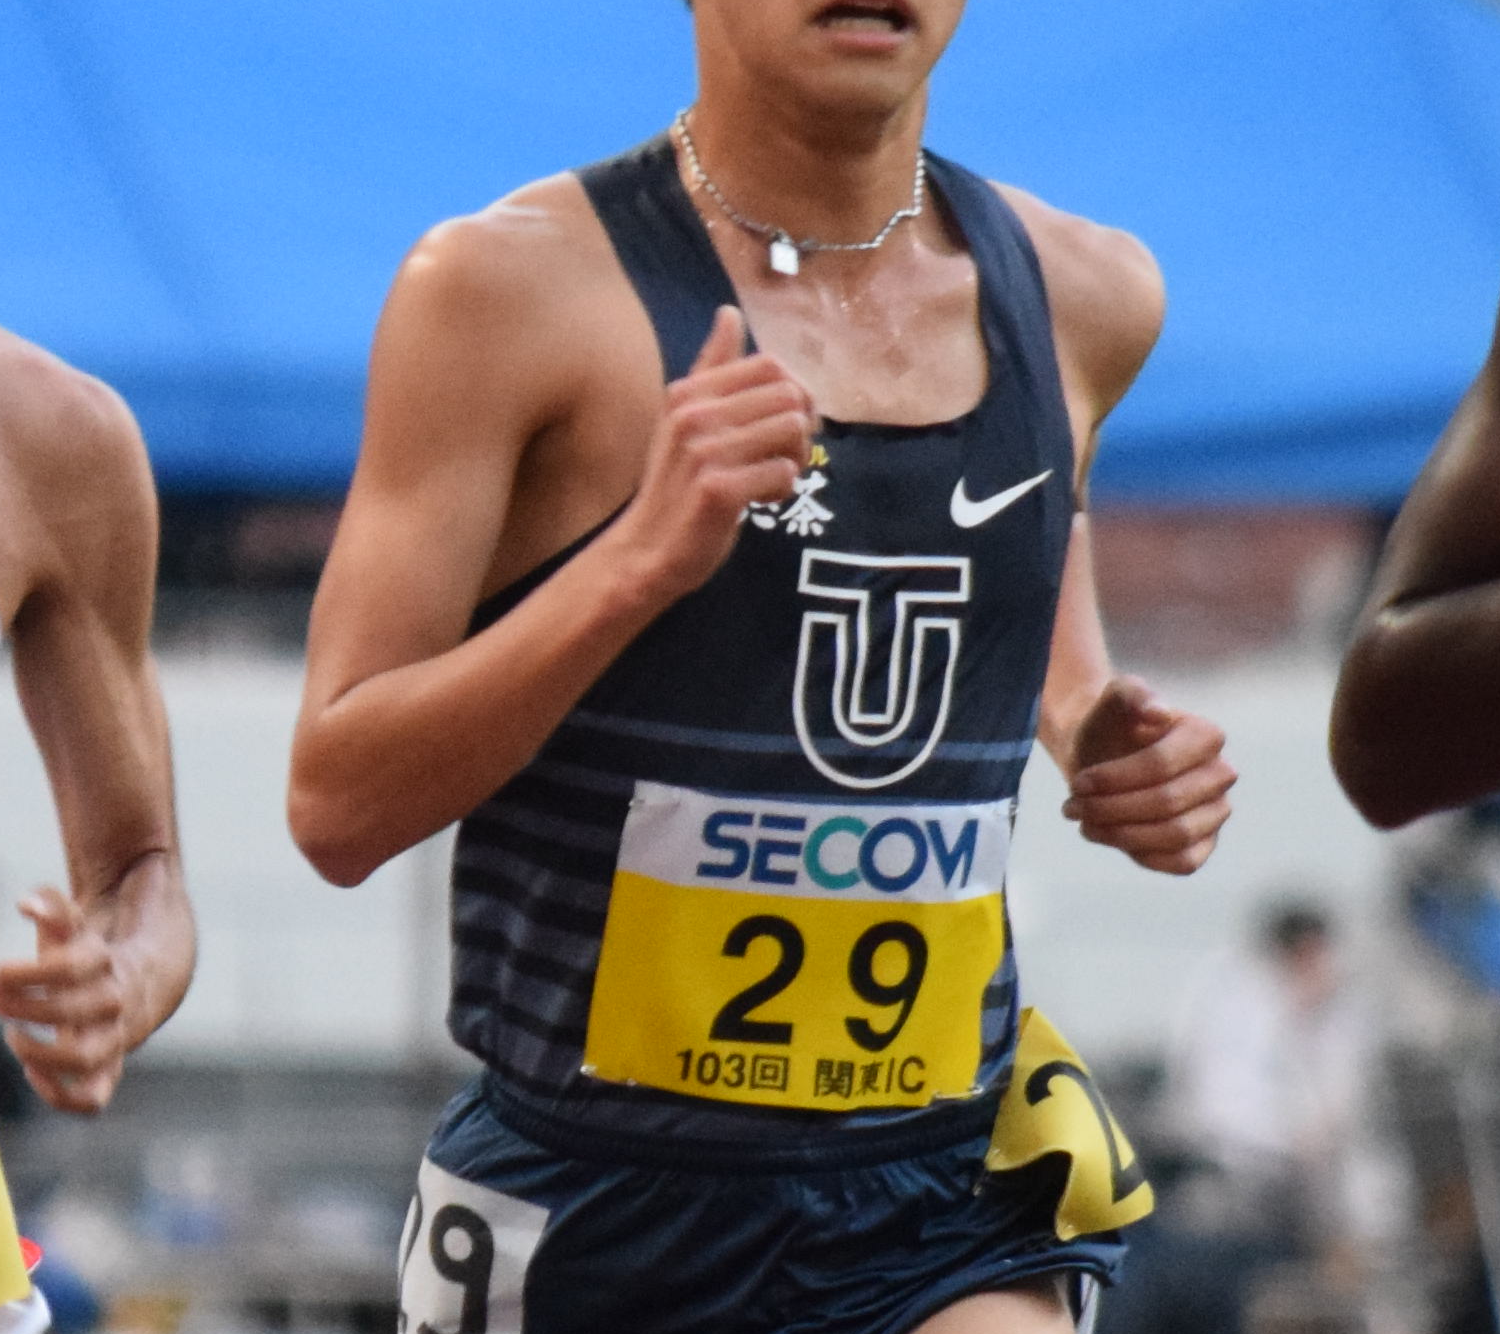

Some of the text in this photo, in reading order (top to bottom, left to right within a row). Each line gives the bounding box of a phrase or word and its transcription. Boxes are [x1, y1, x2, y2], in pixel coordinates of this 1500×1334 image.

[696, 811, 978, 893] SECOM
[708, 914, 930, 1053] 29
[675, 1048, 927, 1100] 103回 関東IC
